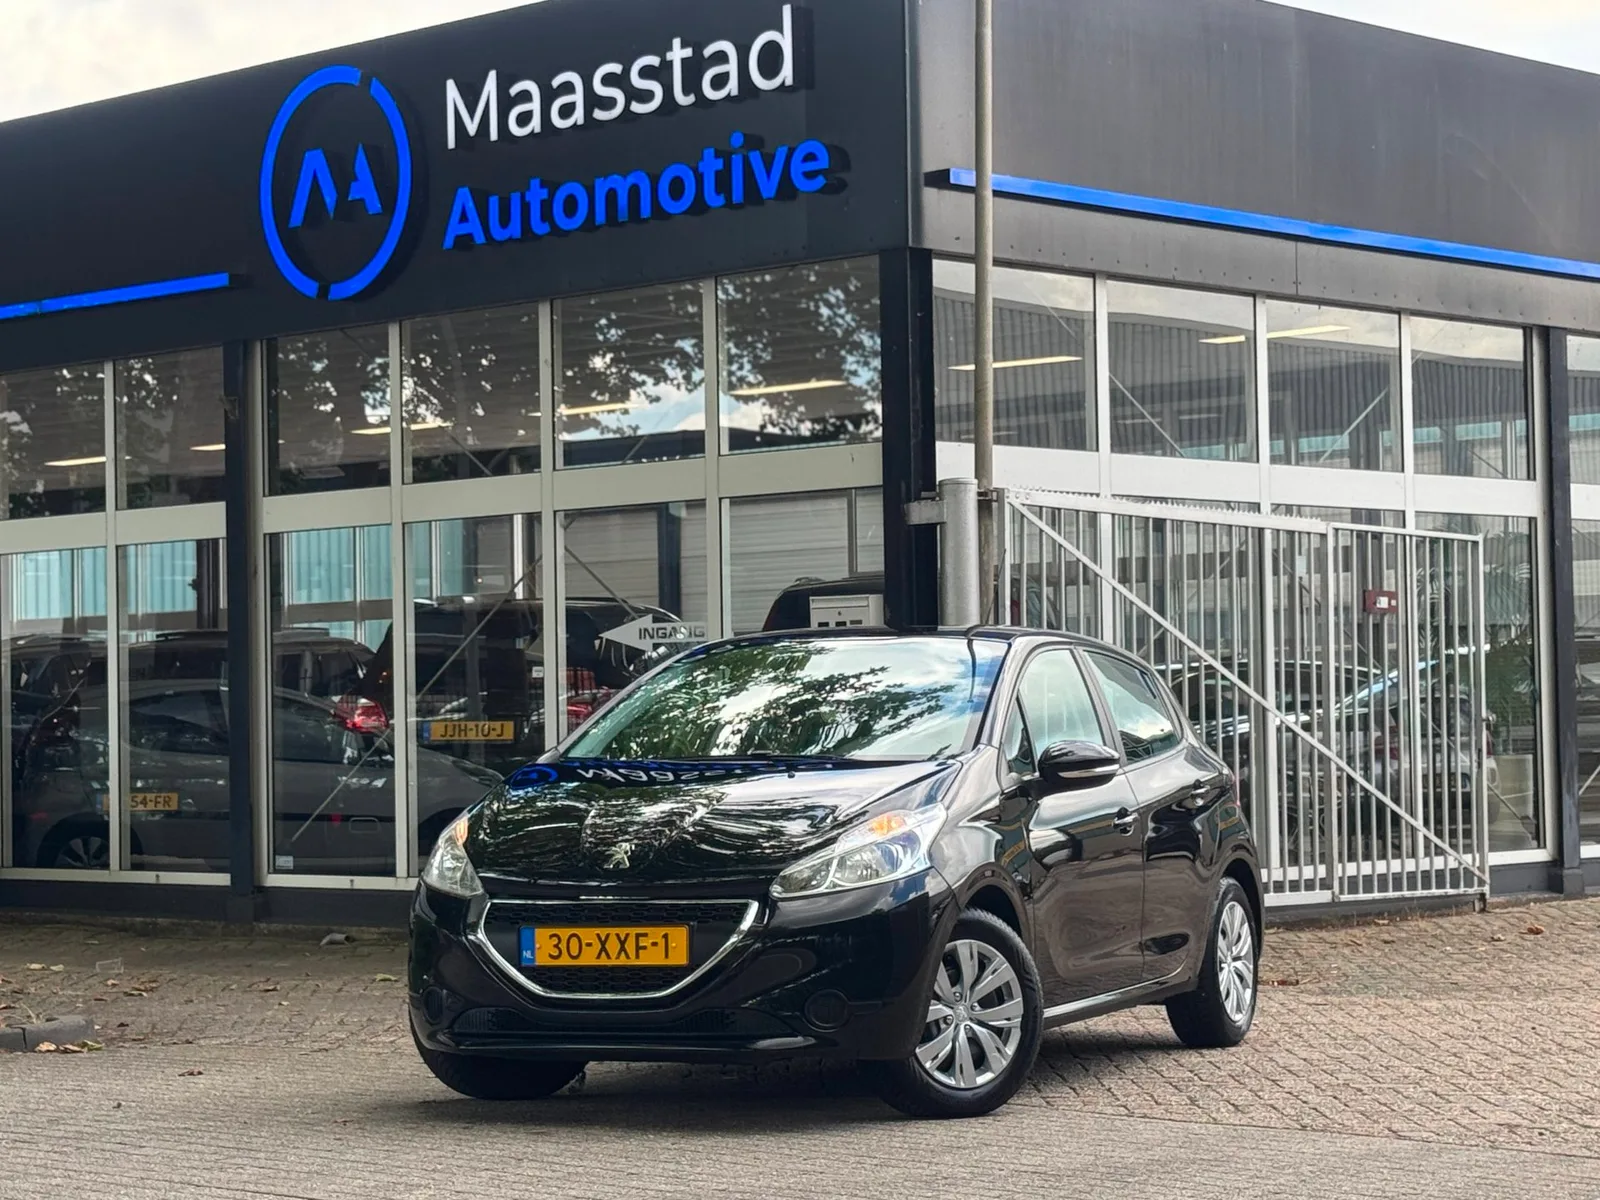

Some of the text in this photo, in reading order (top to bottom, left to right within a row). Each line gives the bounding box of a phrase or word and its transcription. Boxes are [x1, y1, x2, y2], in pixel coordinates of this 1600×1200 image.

[446, 4, 796, 150] Maasstad
[441, 131, 831, 250] Automotive
[440, 723, 505, 738] JJH-10-J
[522, 950, 535, 959] NL
[547, 932, 670, 961] 30-XXF-1
